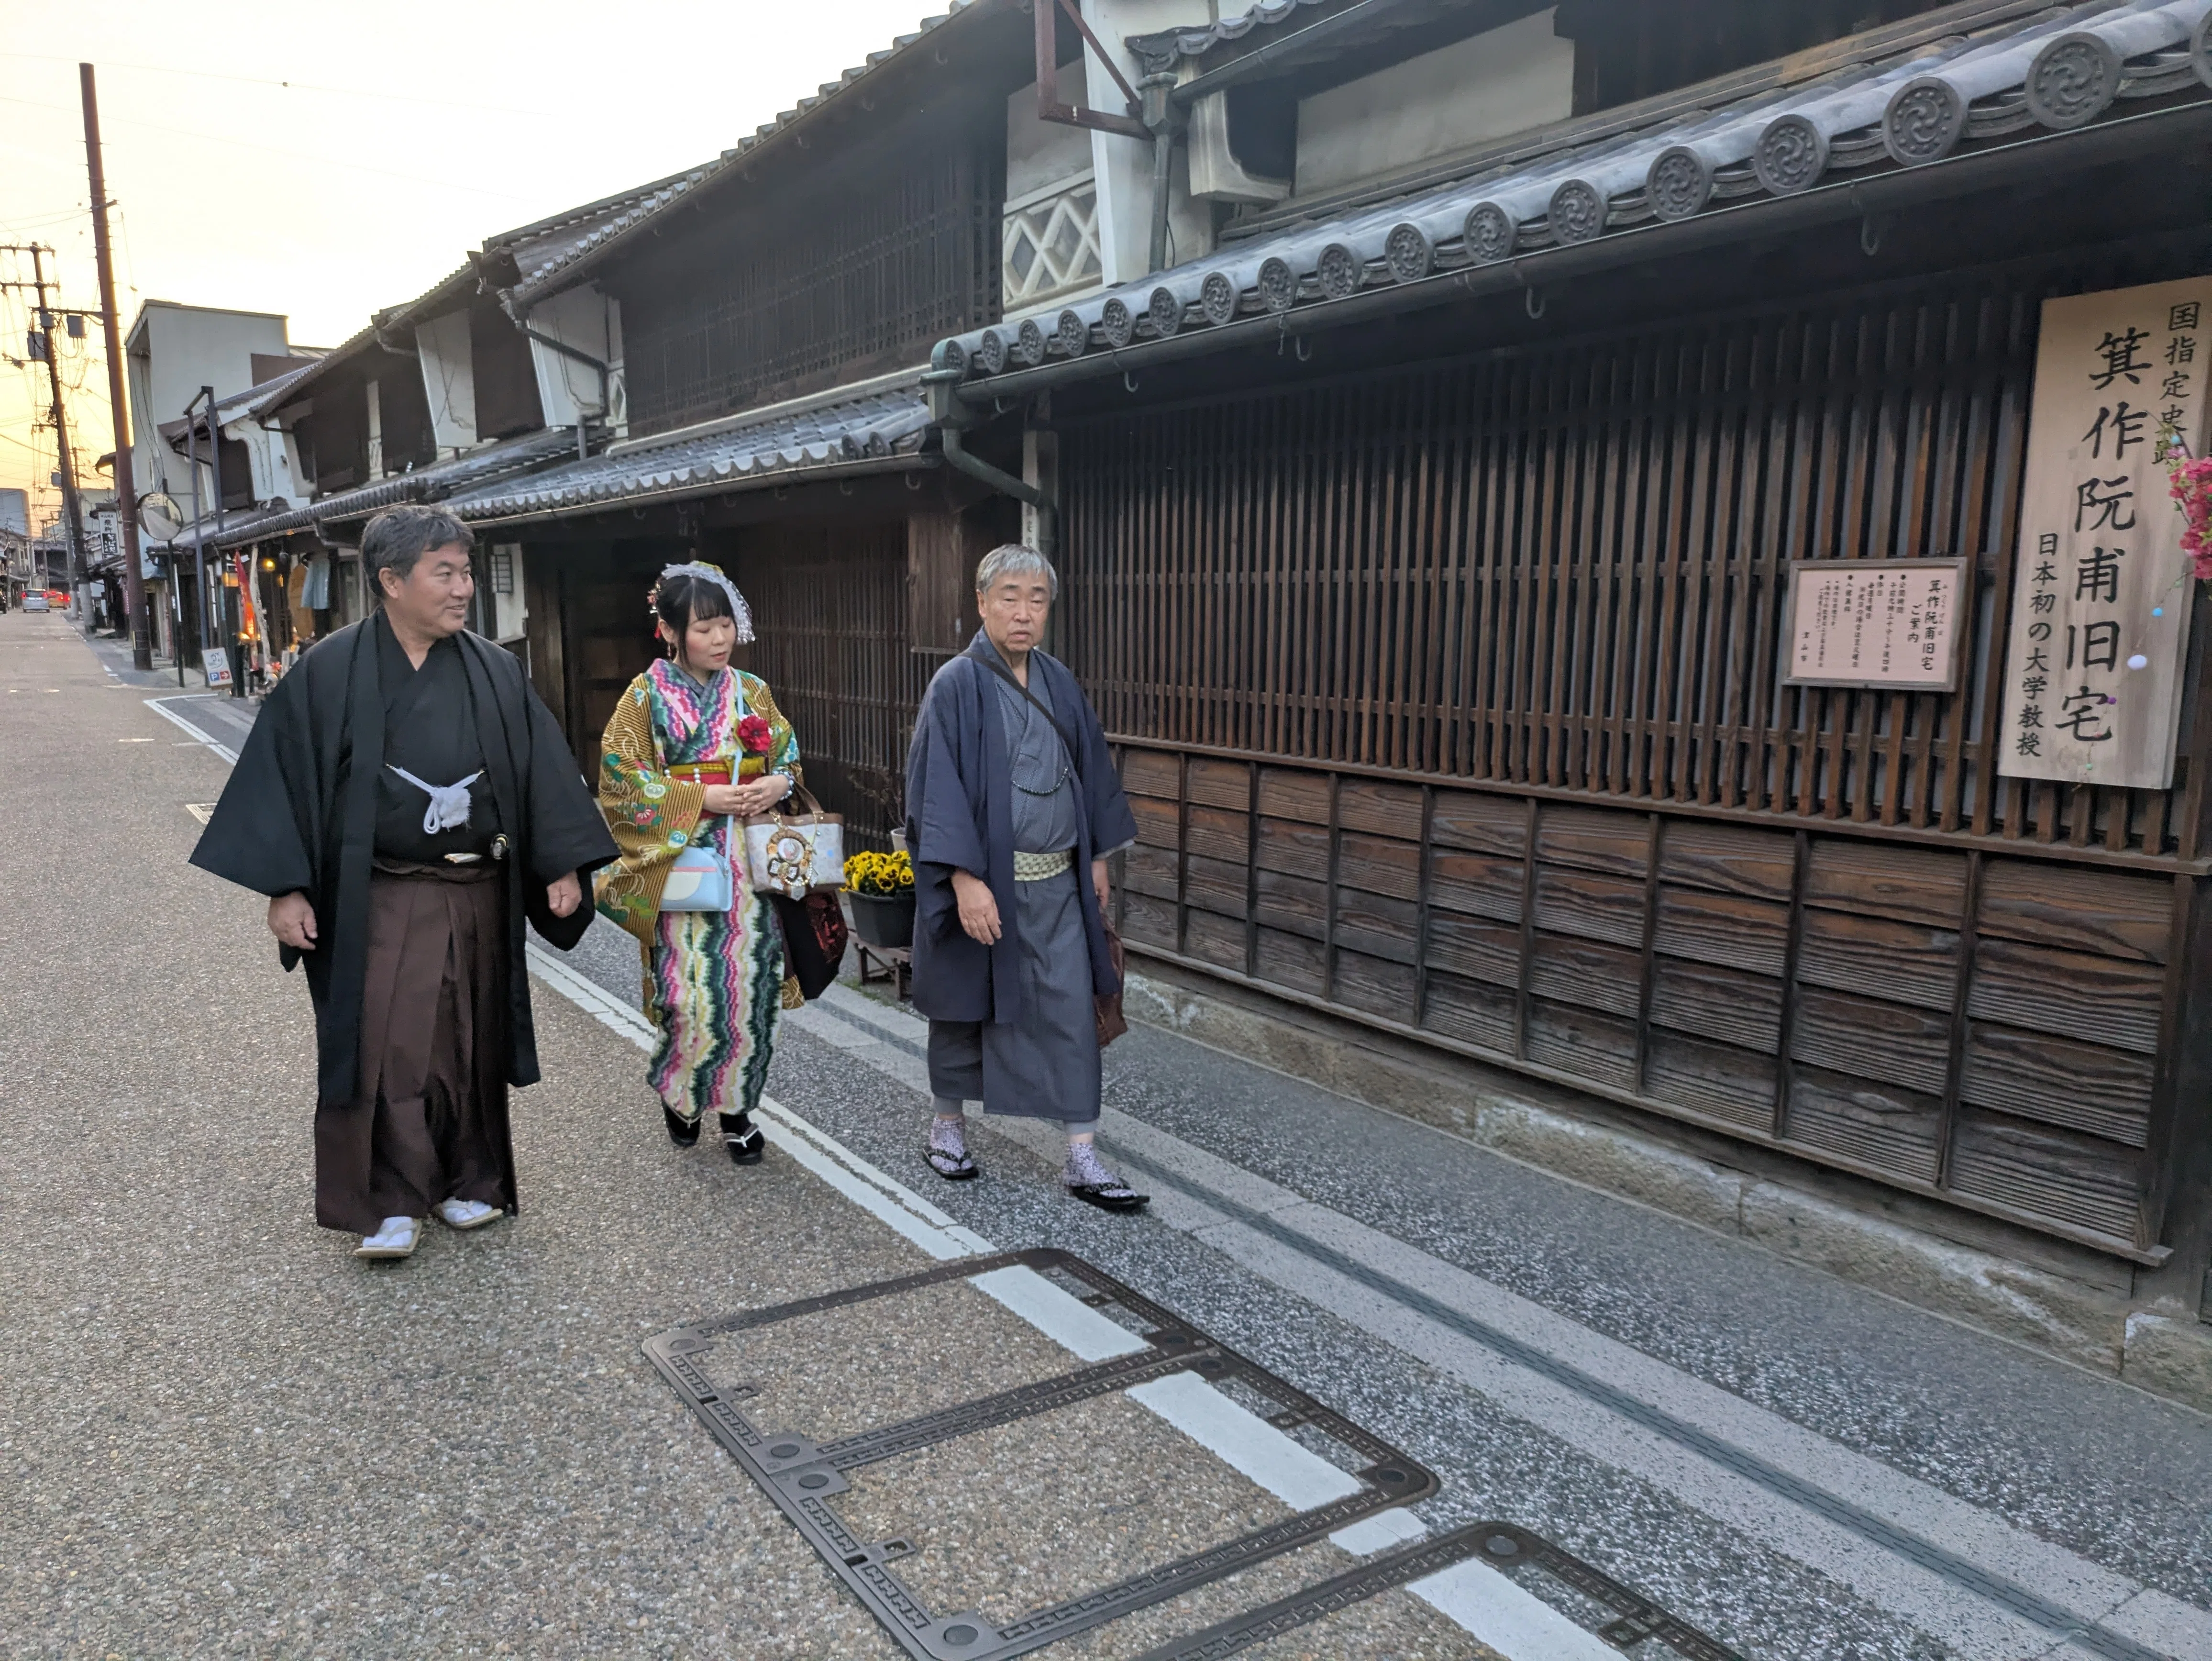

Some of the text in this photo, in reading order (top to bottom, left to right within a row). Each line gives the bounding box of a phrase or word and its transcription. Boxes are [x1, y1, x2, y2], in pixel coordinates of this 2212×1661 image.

[2015, 532, 2058, 757] 日本初の大学教授
[2054, 327, 2153, 743] 箕作阮甫旧宅
